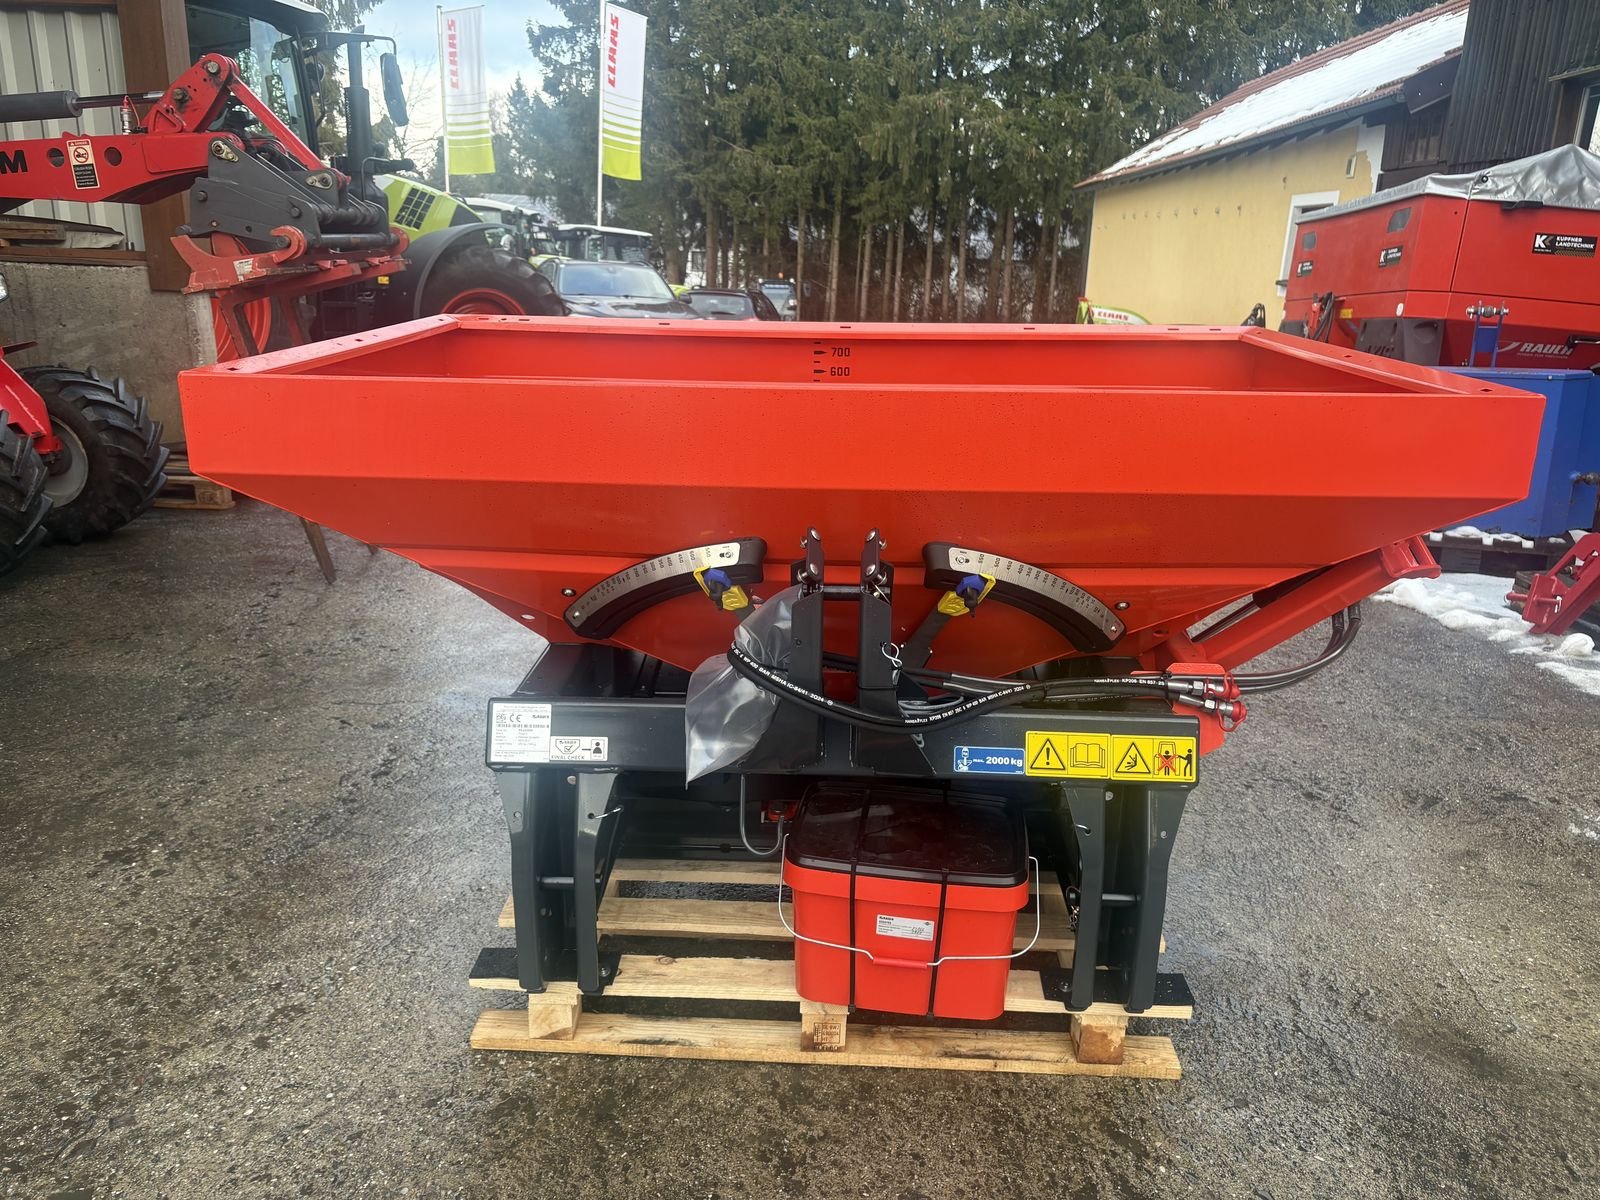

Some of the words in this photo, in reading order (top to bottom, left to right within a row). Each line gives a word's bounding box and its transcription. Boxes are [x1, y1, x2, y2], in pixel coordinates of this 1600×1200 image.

[832, 347, 850, 357] 700
[1520, 342, 1574, 356] RAUCH
[830, 366, 850, 376] 600
[758, 667, 770, 676] BAR
[770, 674, 787, 686] MSHA
[986, 756, 1010, 765] 2000
[1010, 757, 1022, 768] kg
